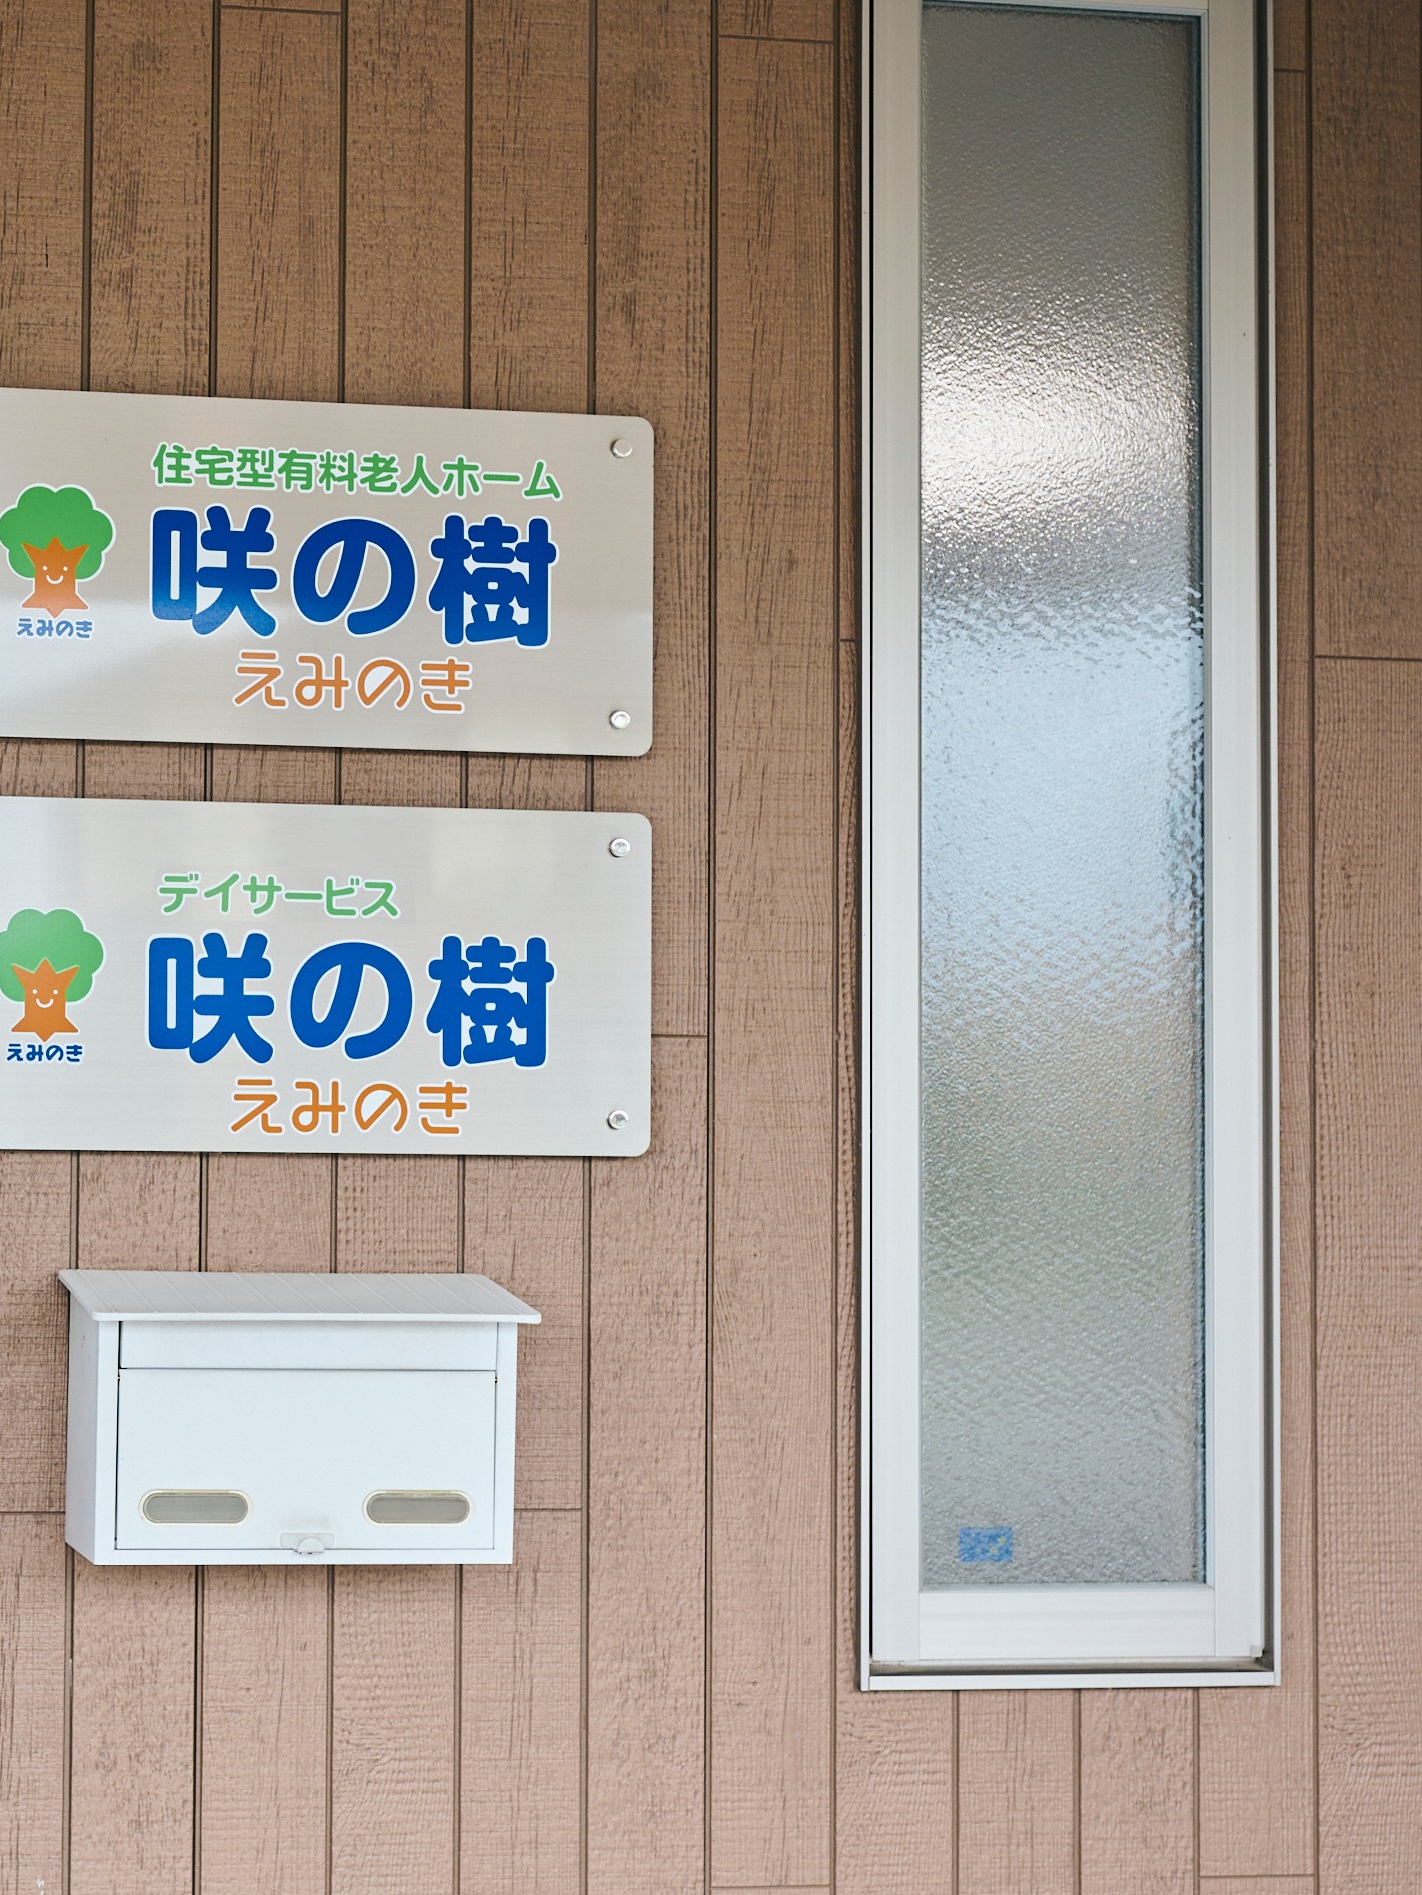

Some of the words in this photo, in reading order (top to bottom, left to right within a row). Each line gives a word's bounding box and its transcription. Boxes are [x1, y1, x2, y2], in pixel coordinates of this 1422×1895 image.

[152, 444, 561, 499] 住宅型有料老人ホーム
[151, 505, 557, 647] 咲の樹
[16, 617, 93, 639] えみのき
[235, 652, 470, 712] えみのき
[159, 873, 398, 917] デイサービス
[148, 932, 555, 1067] 咲の樹
[6, 1043, 83, 1063] えみのき
[231, 1079, 468, 1134] えみのき
